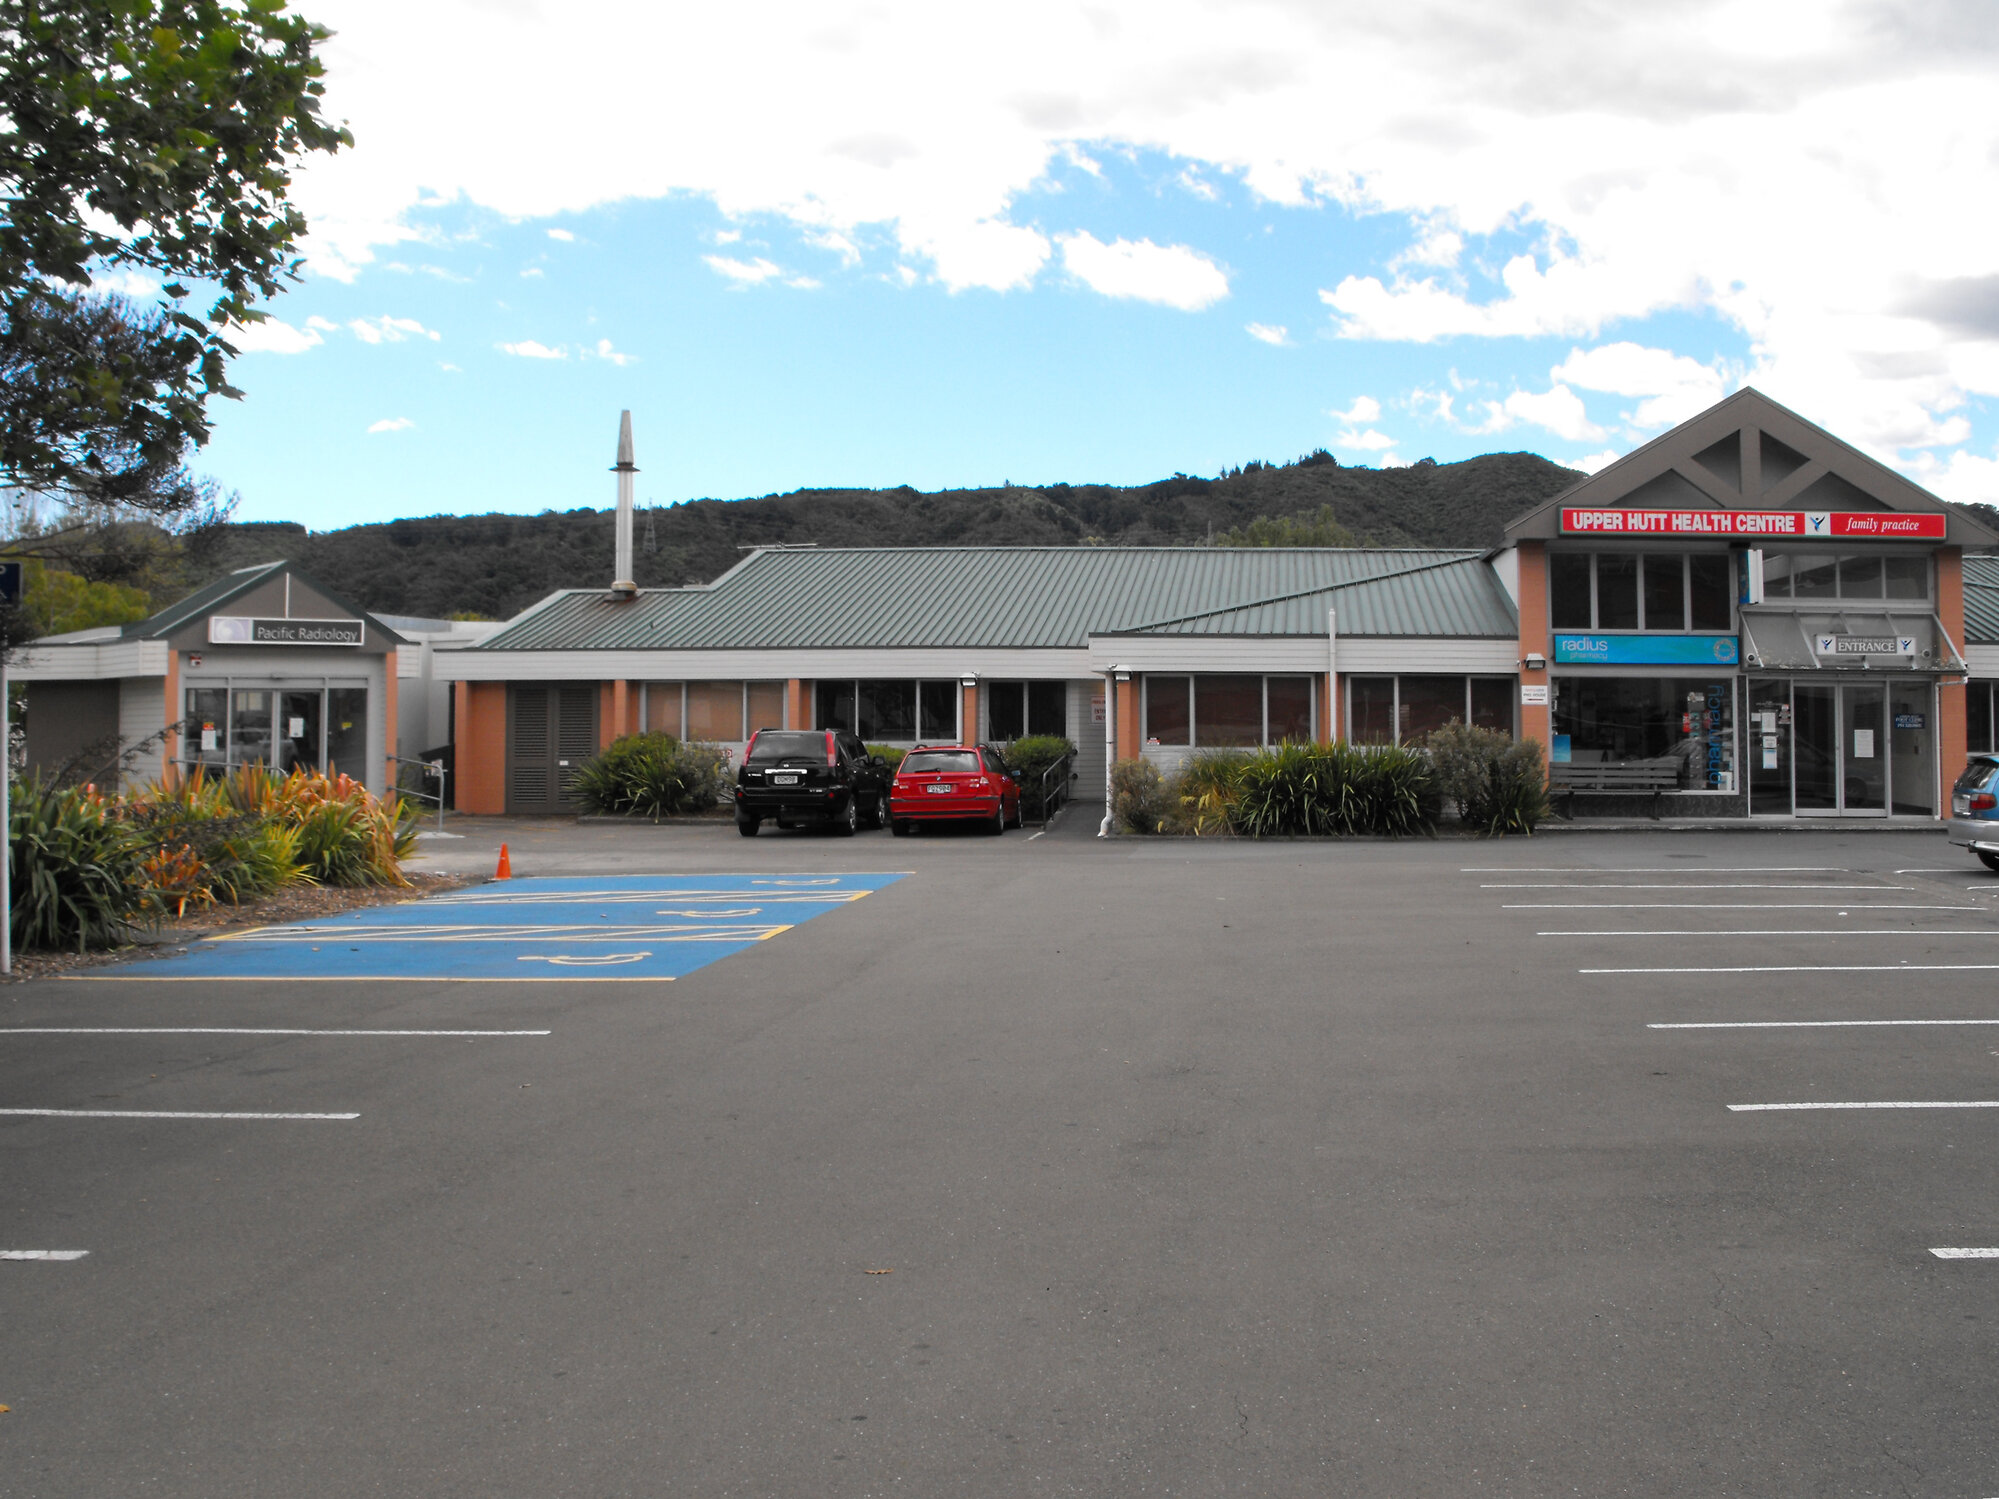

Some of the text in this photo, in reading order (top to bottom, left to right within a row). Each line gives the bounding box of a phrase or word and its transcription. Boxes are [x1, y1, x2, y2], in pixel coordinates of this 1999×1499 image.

[1573, 511, 1796, 533] UPPER HUTT HEALTH CENTRE
[1845, 516, 1920, 533] family practice
[257, 626, 358, 643] Pacific Radiology
[1562, 636, 1608, 652] radius
[1837, 642, 1896, 652] ENTRANCE
[1707, 685, 1725, 785] pharmacy
